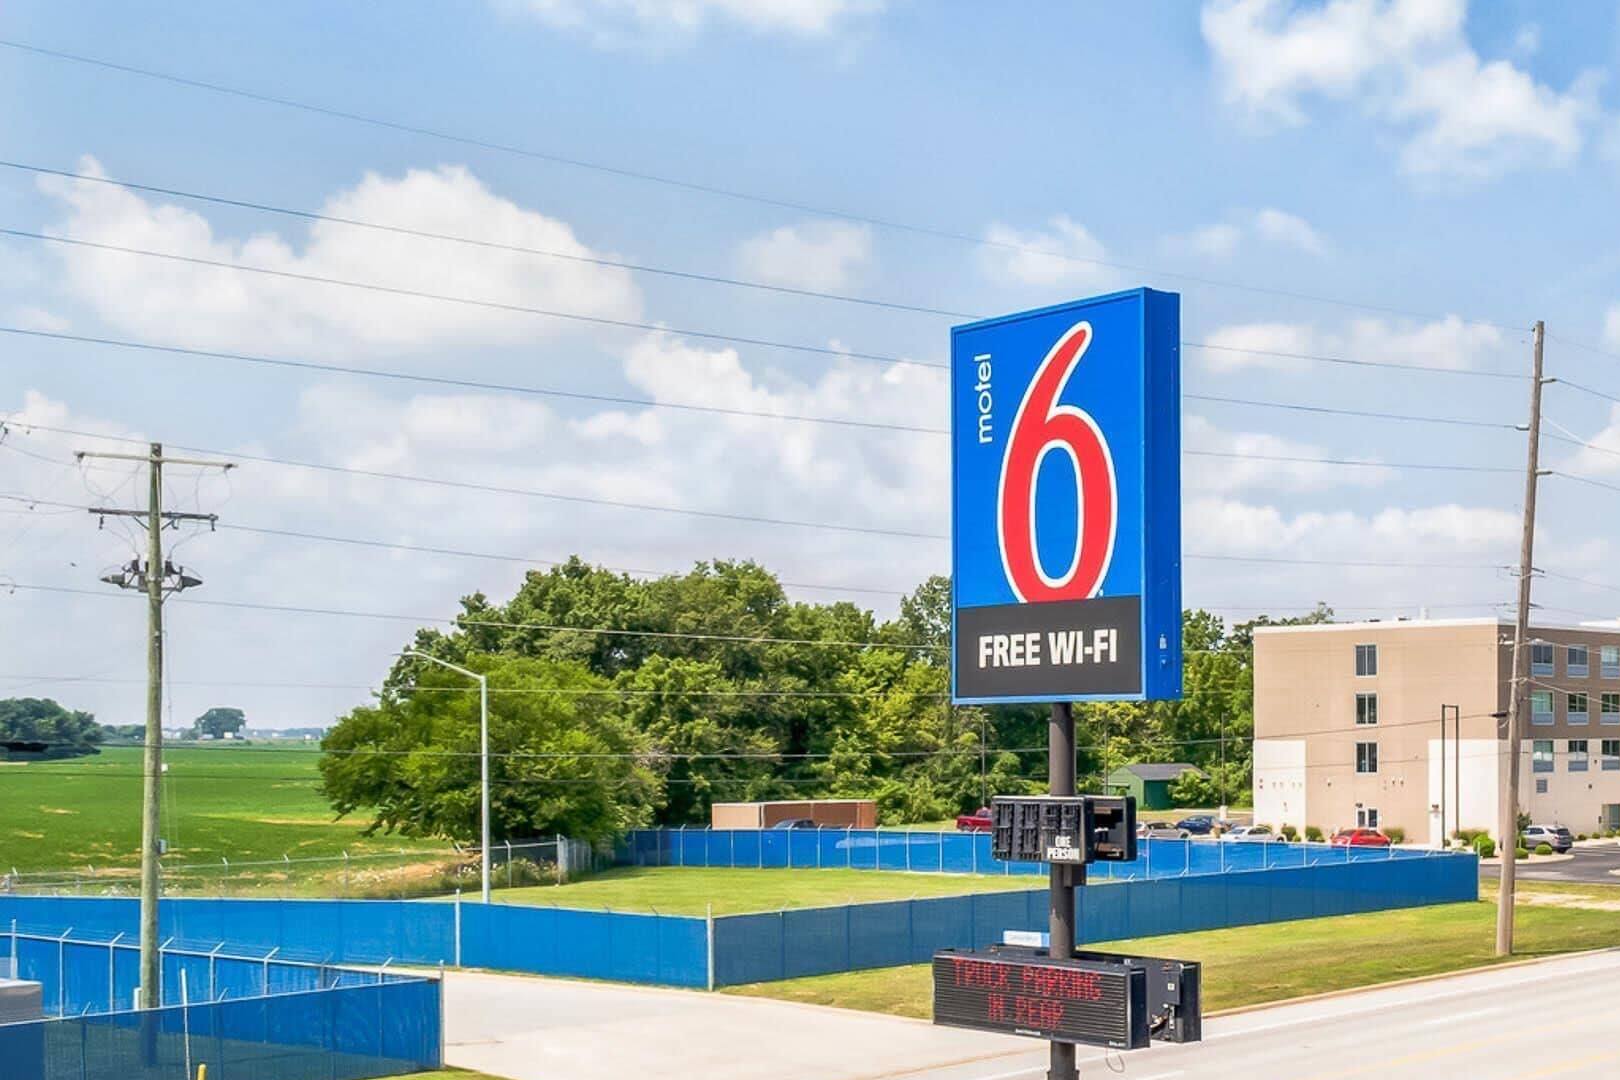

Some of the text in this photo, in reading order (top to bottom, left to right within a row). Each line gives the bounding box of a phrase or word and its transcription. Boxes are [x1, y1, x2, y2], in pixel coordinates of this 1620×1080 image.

[974, 321, 1118, 603] motel 6
[979, 629, 1117, 668] FREE WI-FI
[1055, 835, 1072, 848] ONE
[953, 957, 1102, 1001] TRUCK PARKING
[1015, 995, 1065, 1030] REAR
